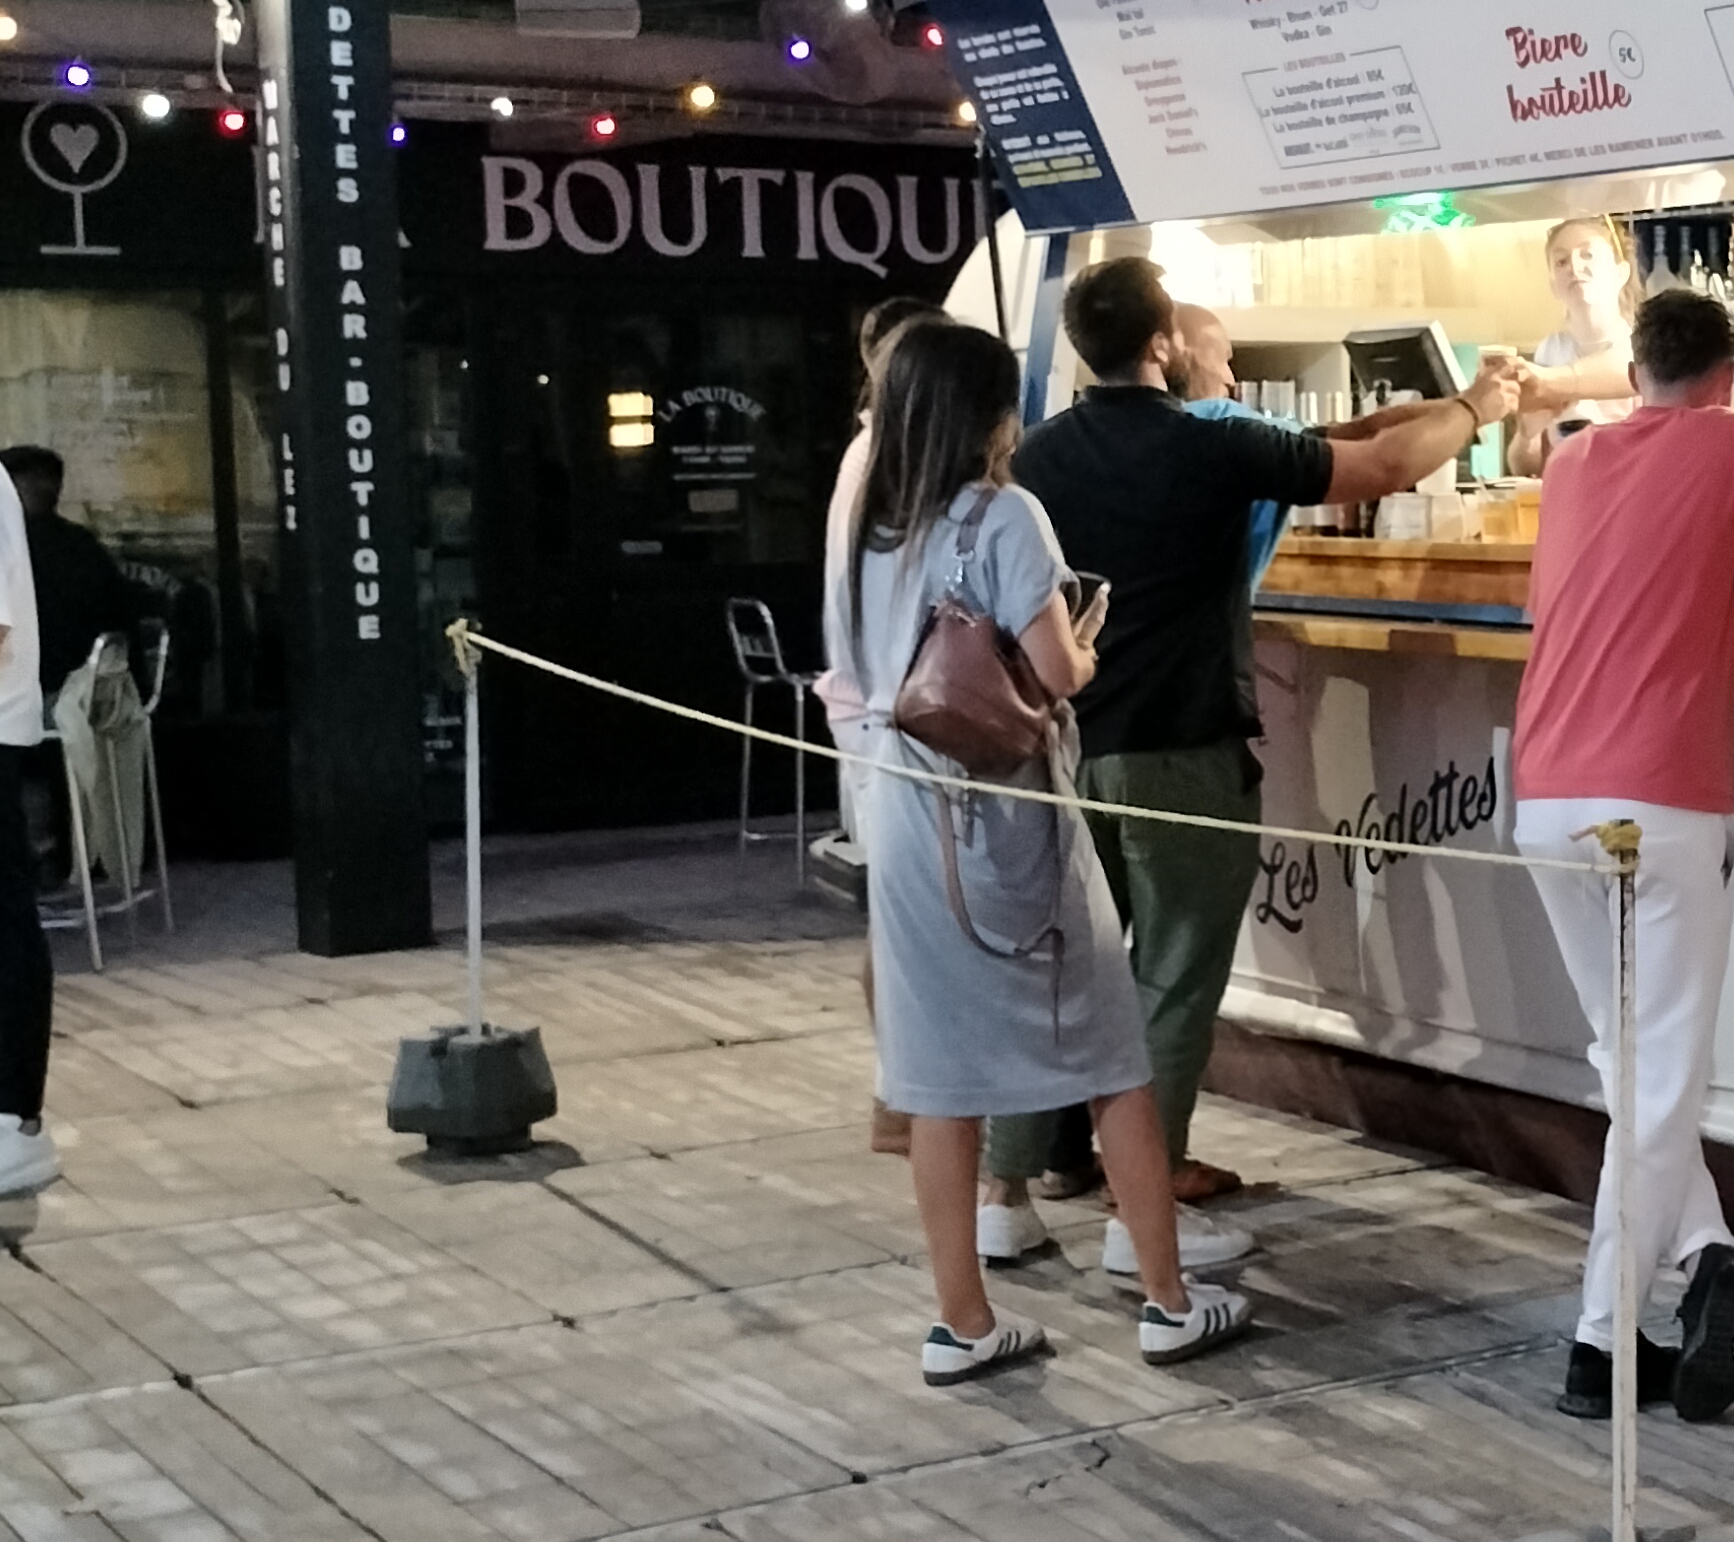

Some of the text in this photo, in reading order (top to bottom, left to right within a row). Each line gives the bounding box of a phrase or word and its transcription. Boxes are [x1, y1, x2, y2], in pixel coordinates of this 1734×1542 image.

[1505, 26, 1636, 69] Biere 5€
[1506, 69, 1632, 123] bouteille
[1256, 756, 1497, 934] Les Vedettes
